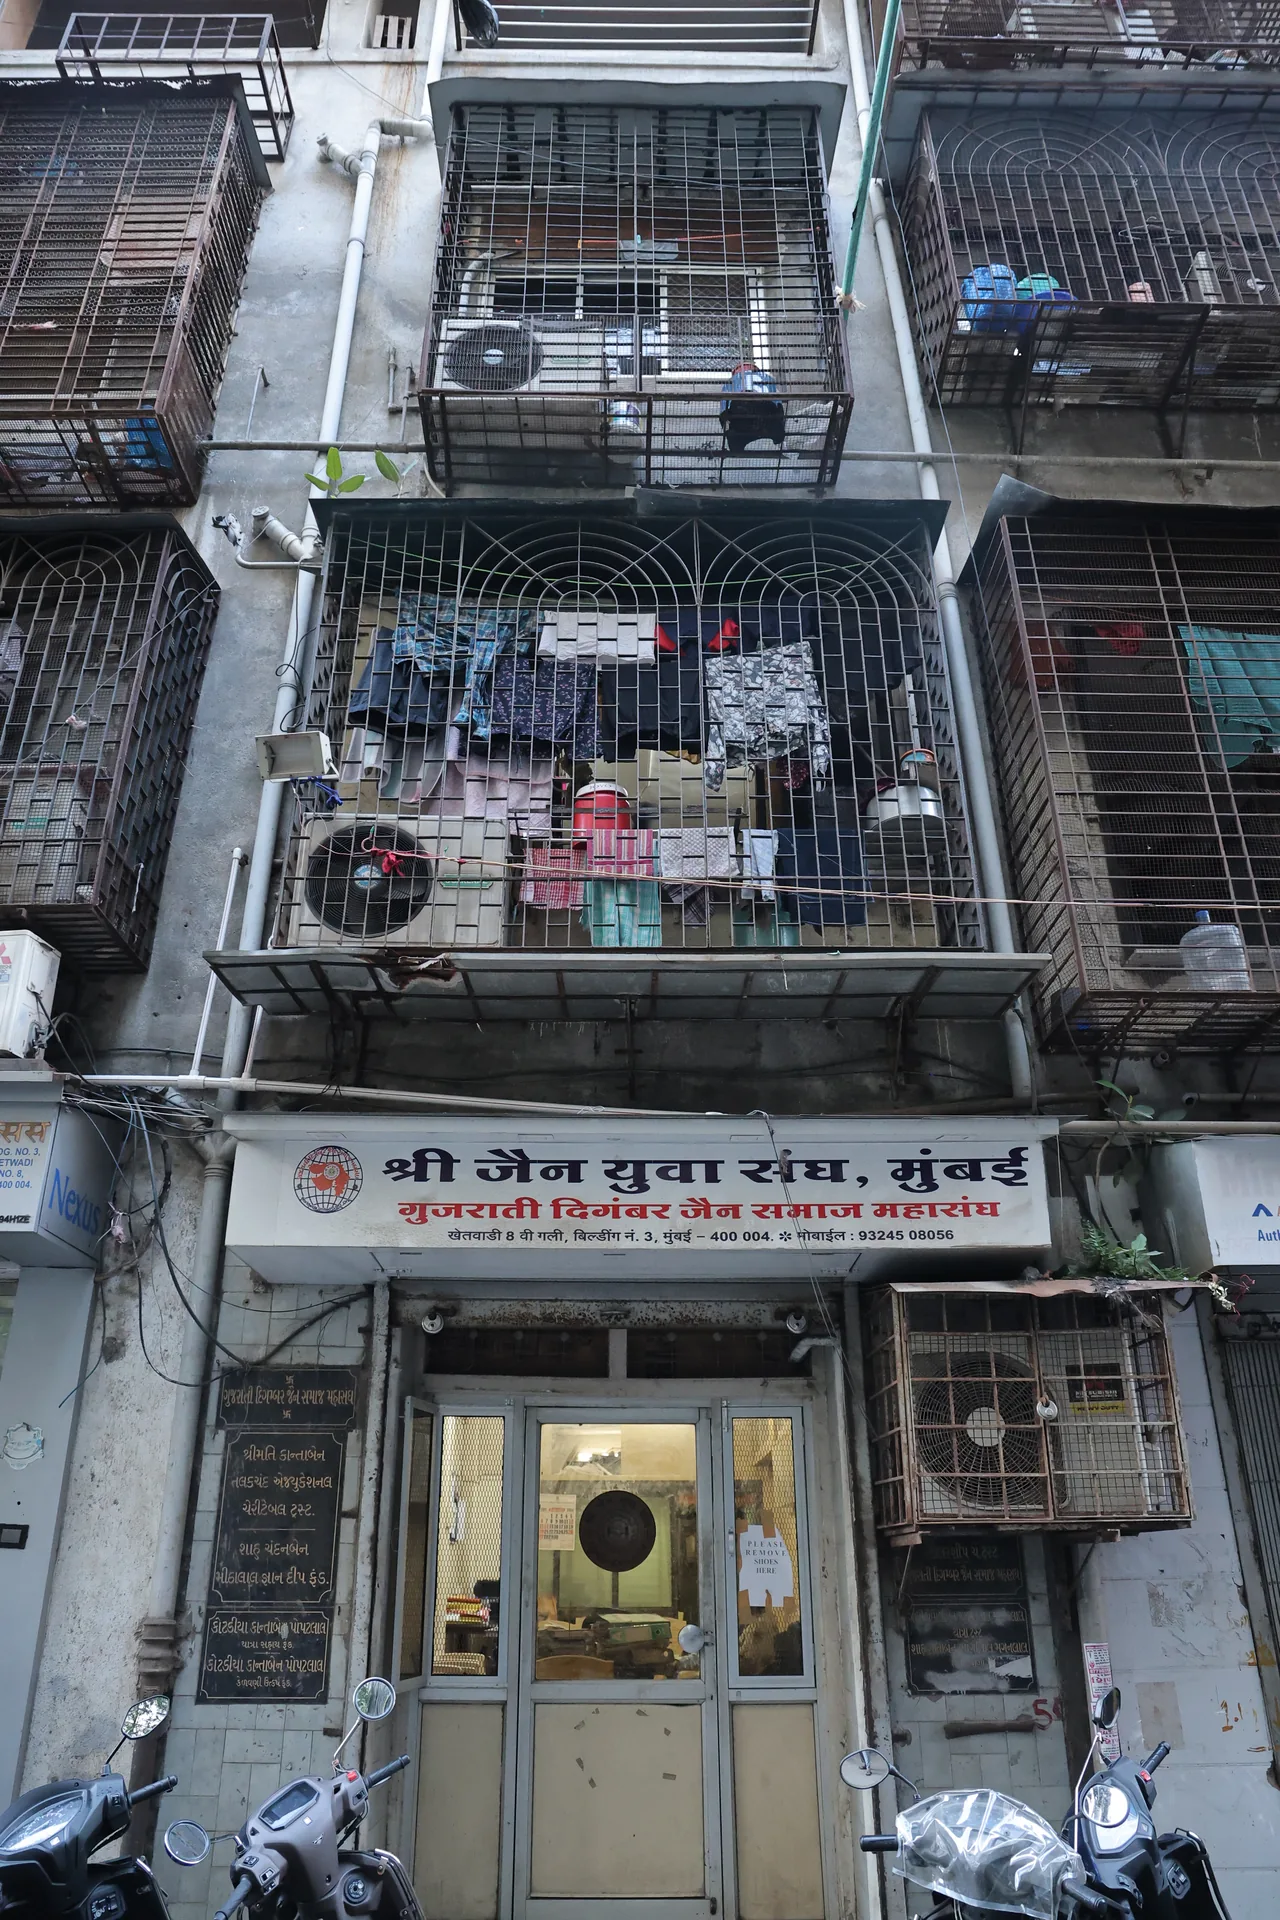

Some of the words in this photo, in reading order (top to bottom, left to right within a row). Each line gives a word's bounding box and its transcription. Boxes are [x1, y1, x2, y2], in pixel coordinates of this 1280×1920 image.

[15, 1147, 31, 1156] NO.
[382, 1147, 460, 1183] श्री
[474, 1148, 588, 1183] जैन
[603, 1158, 725, 1195] युवा
[738, 1148, 869, 1189] संघ,
[886, 1147, 1029, 1195] मुंबई
[15, 1180, 32, 1189] 004.
[48, 1167, 101, 1236] Nexus
[398, 1196, 540, 1226] गुजराती
[550, 1196, 671, 1220] दिगंबर
[680, 1197, 742, 1220] जैन
[752, 1203, 863, 1220] समाज
[872, 1195, 1000, 1220] महासंघ
[448, 1228, 502, 1242] खेतवाडी
[505, 1232, 514, 1241] 8
[519, 1228, 534, 1241] वी
[537, 1228, 568, 1244] गली,
[573, 1227, 621, 1242] बिल्डींग
[624, 1228, 639, 1241] नं.
[644, 1232, 658, 1244] 3,
[662, 1227, 691, 1245] मुंबई
[710, 1231, 738, 1242] 400
[742, 1231, 774, 1242] 004.
[858, 1230, 904, 1242] 93245
[908, 1229, 955, 1241] 08056
[243, 1444, 277, 1462] શ્રીમતિ
[278, 1445, 326, 1462] કાન્તાબેન
[745, 1549, 787, 1557] REMOVE
